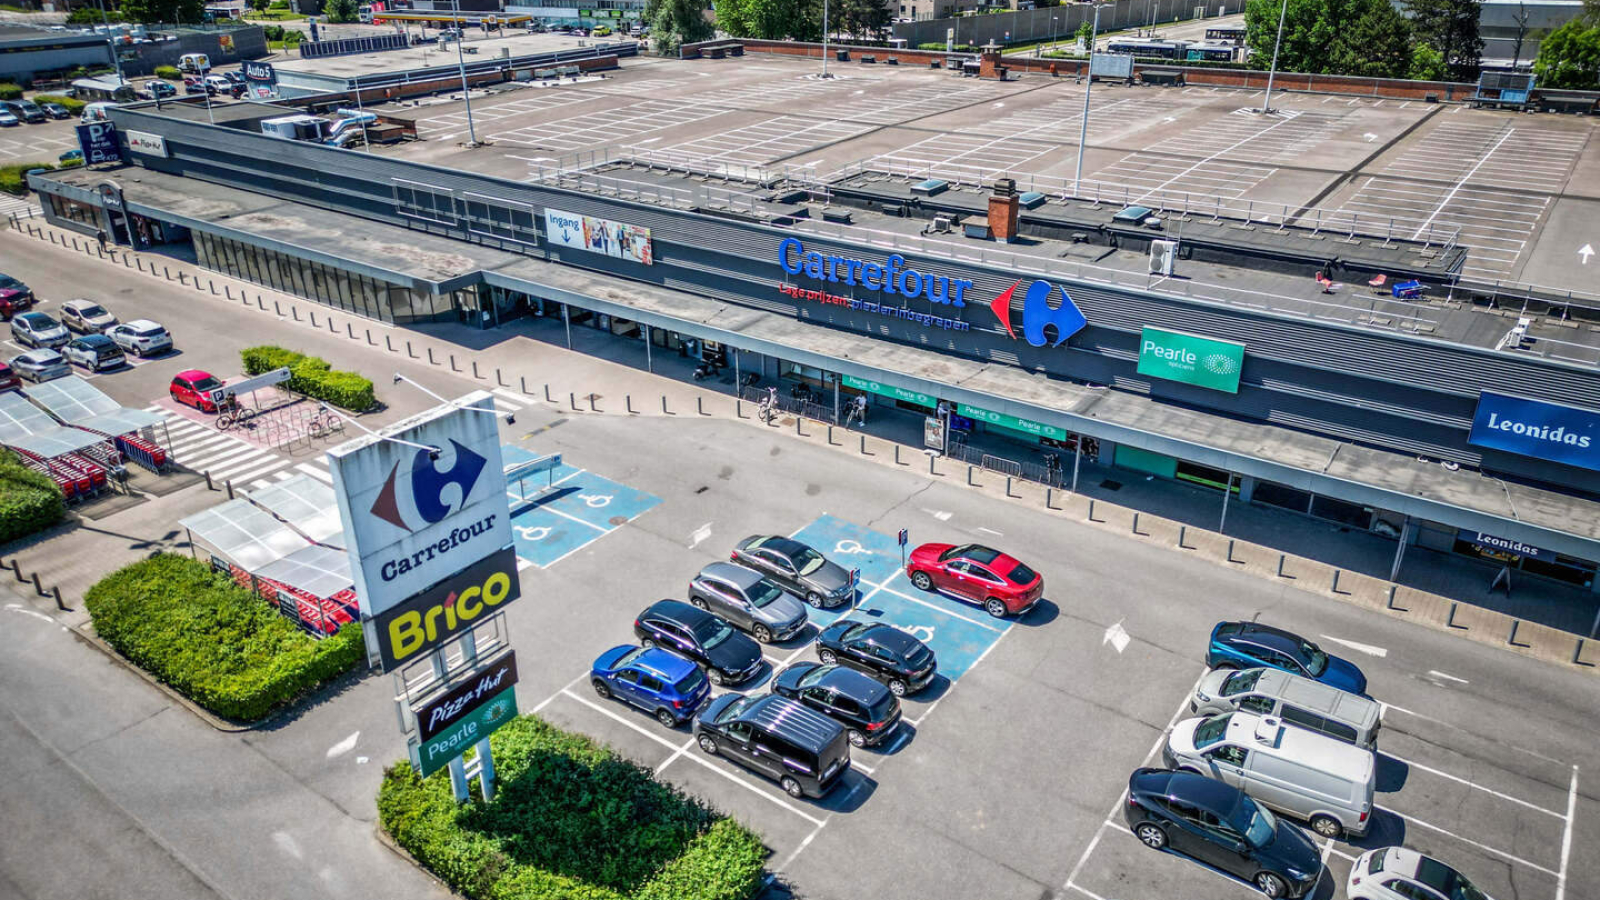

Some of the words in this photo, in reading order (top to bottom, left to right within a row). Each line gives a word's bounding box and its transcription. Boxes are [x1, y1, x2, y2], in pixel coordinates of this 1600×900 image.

[247, 64, 265, 77] Auto
[265, 66, 271, 77] 5
[89, 125, 104, 142] P
[549, 213, 580, 231] Ingang
[778, 237, 974, 308] Carrefour
[779, 283, 805, 298] Lage
[851, 298, 893, 317] plezier
[894, 305, 970, 331] inbegrepen
[1143, 340, 1196, 364] Pearle
[215, 391, 222, 400] P
[1488, 412, 1592, 448] Leonidas
[381, 514, 497, 582] Carrefour
[1476, 532, 1539, 555] Leonidas
[388, 572, 511, 660] Brico
[428, 690, 475, 732] Pizza
[475, 667, 509, 699] Hut
[428, 721, 477, 760] Pearle
